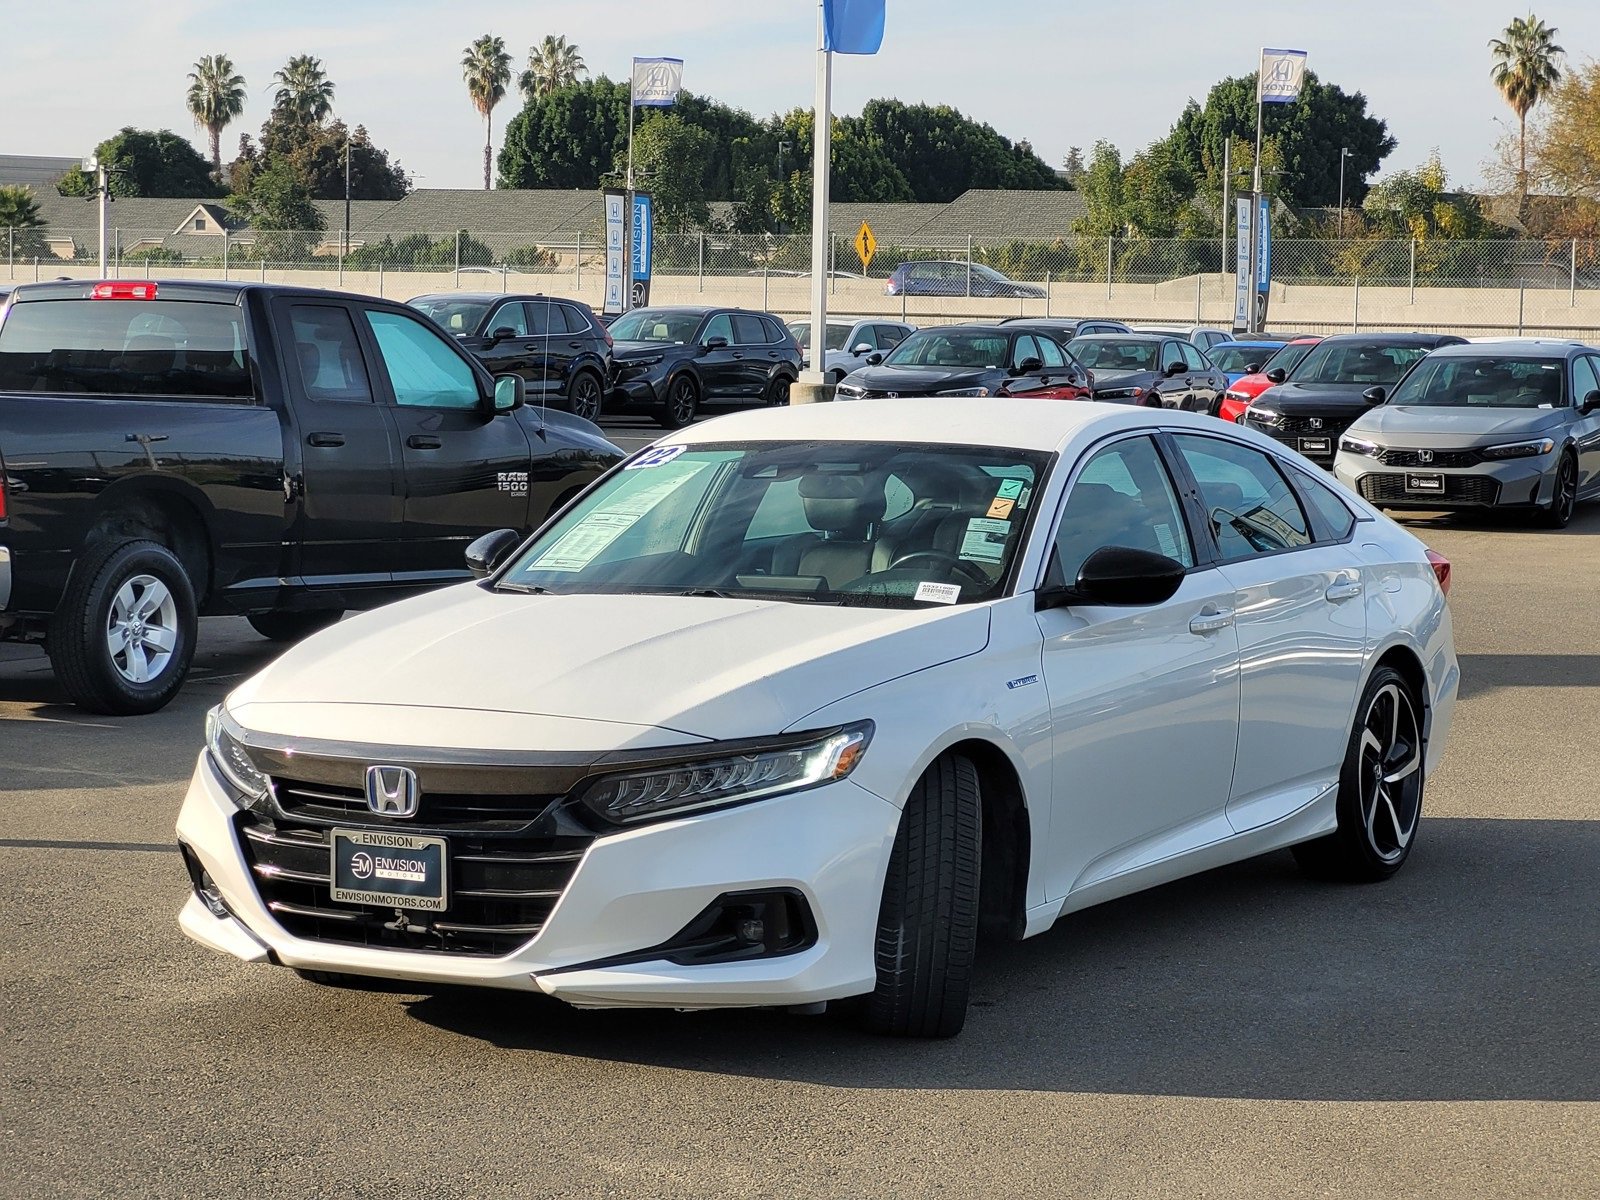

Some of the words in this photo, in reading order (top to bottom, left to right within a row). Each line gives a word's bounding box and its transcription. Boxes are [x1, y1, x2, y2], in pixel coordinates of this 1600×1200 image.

[632, 203, 641, 273] ENVISION
[497, 472, 528, 481] RAM
[497, 481, 528, 491] 1500
[362, 833, 413, 848] ENVISION
[375, 856, 426, 873] ENVISION
[335, 890, 441, 909] ENVISIONMOTORS.COM
